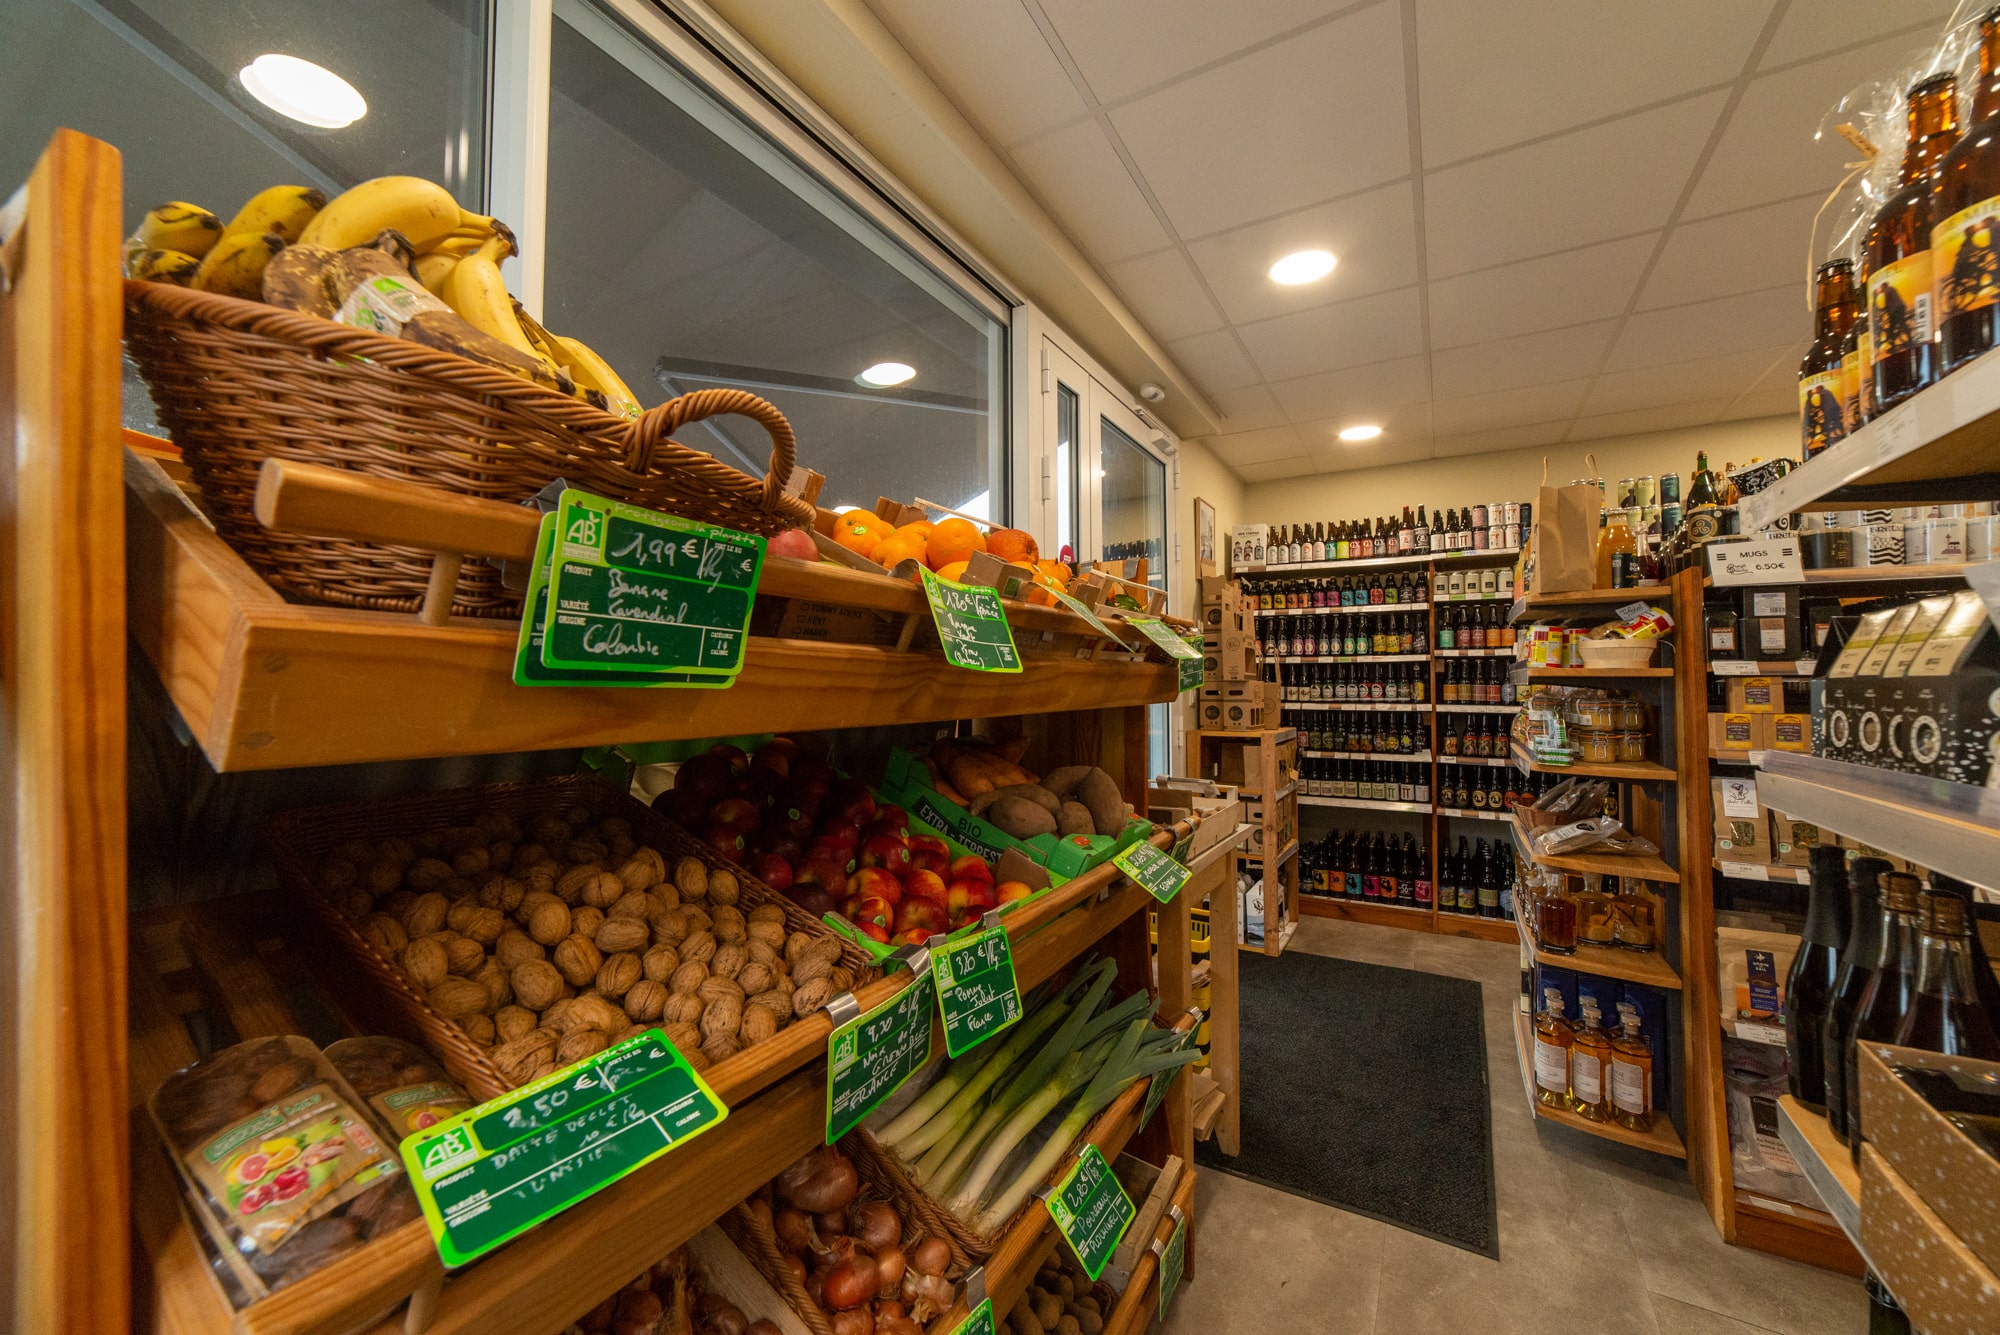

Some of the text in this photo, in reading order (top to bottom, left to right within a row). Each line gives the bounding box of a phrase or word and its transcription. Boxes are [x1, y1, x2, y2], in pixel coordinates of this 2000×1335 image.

[567, 518, 596, 546] AB
[710, 528, 756, 544] planète
[1740, 550, 1768, 558] MUGS
[564, 564, 592, 576] PRODUIT
[1755, 563, 1785, 571] 6.50€
[608, 568, 668, 600] Banane
[560, 599, 589, 611] VARIÉTÉ
[558, 615, 586, 626] ORIGINE
[583, 623, 660, 656] Colombie
[920, 804, 949, 835] EXTRA
[958, 817, 982, 838] BIO
[649, 1047, 666, 1059] €
[834, 1038, 852, 1064] AB
[863, 1045, 886, 1068] Noix
[850, 1061, 899, 1110] FRANCE
[424, 1136, 465, 1169] AB
[1076, 1190, 1112, 1236] Poireaux
